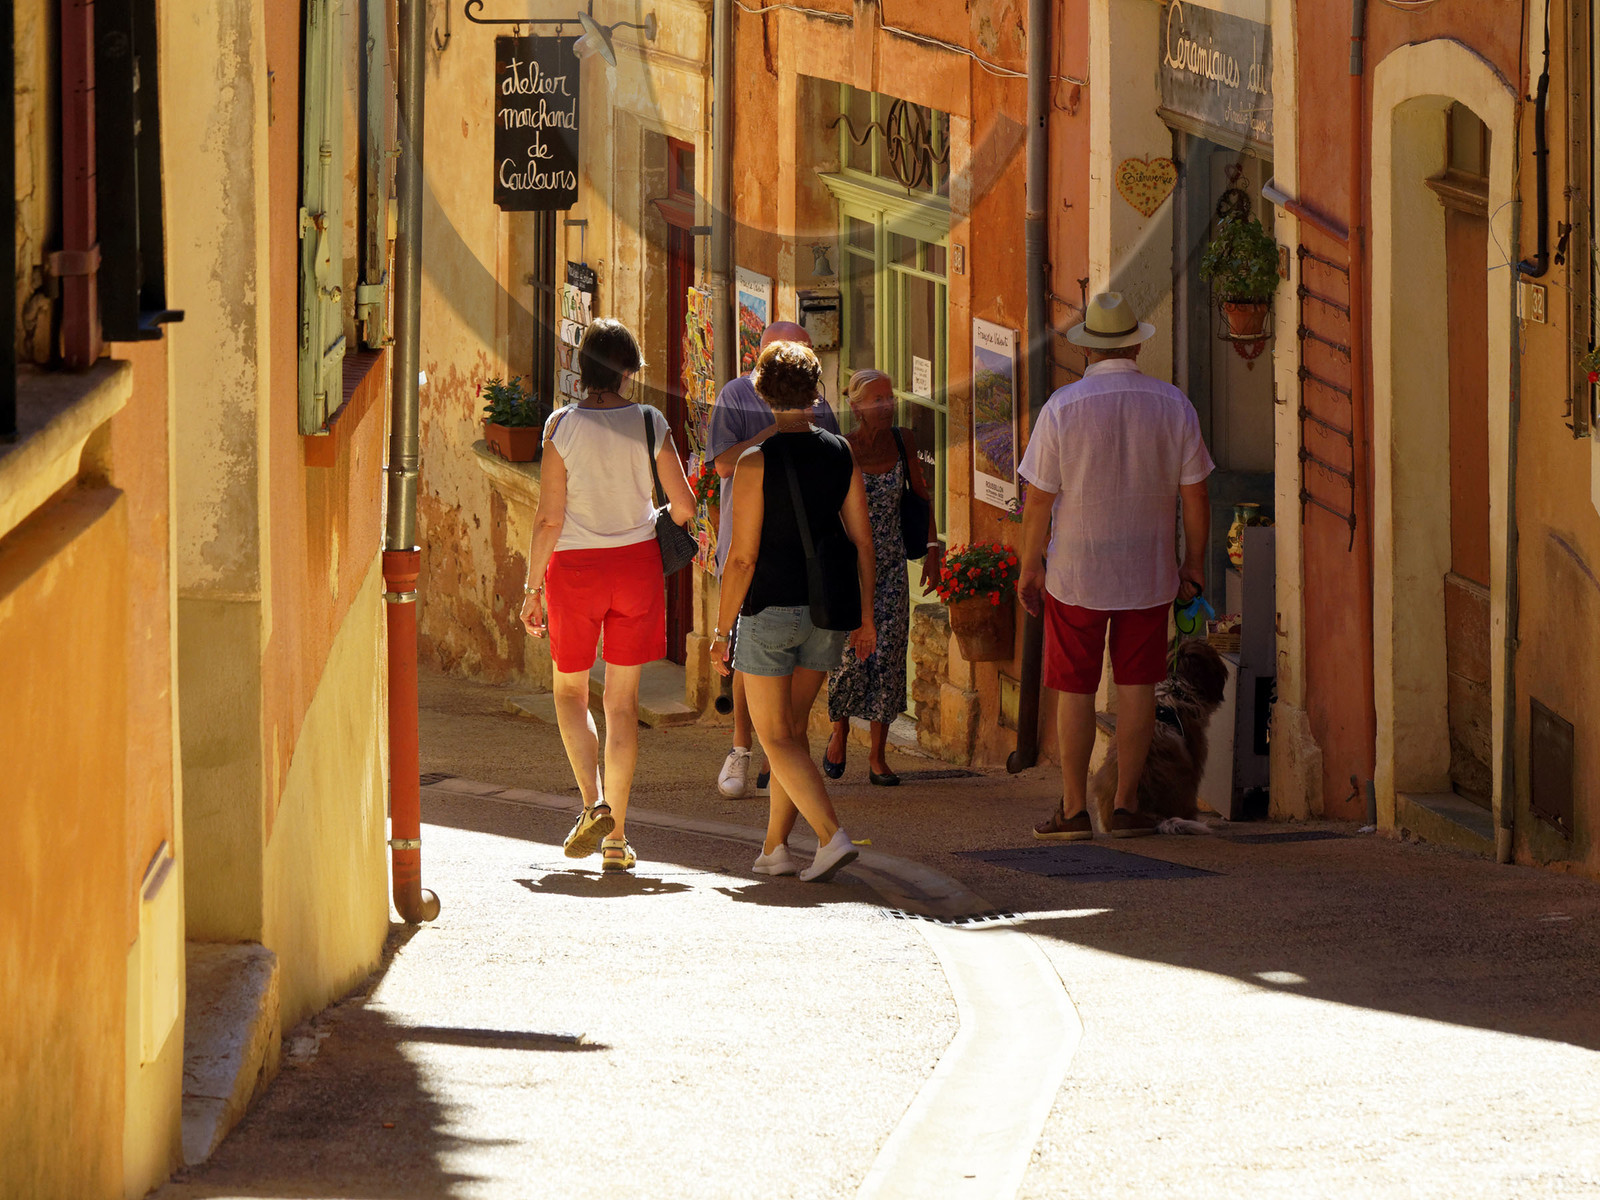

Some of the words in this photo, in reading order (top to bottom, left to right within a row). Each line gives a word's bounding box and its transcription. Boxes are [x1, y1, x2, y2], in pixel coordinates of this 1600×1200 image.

[1163, 0, 1240, 97] Céramiques
[1247, 35, 1268, 96] du
[502, 57, 571, 97] atelier
[498, 97, 578, 131] marchand
[527, 130, 554, 160] de
[499, 158, 577, 191] Couleurs
[1532, 292, 1543, 315] 32
